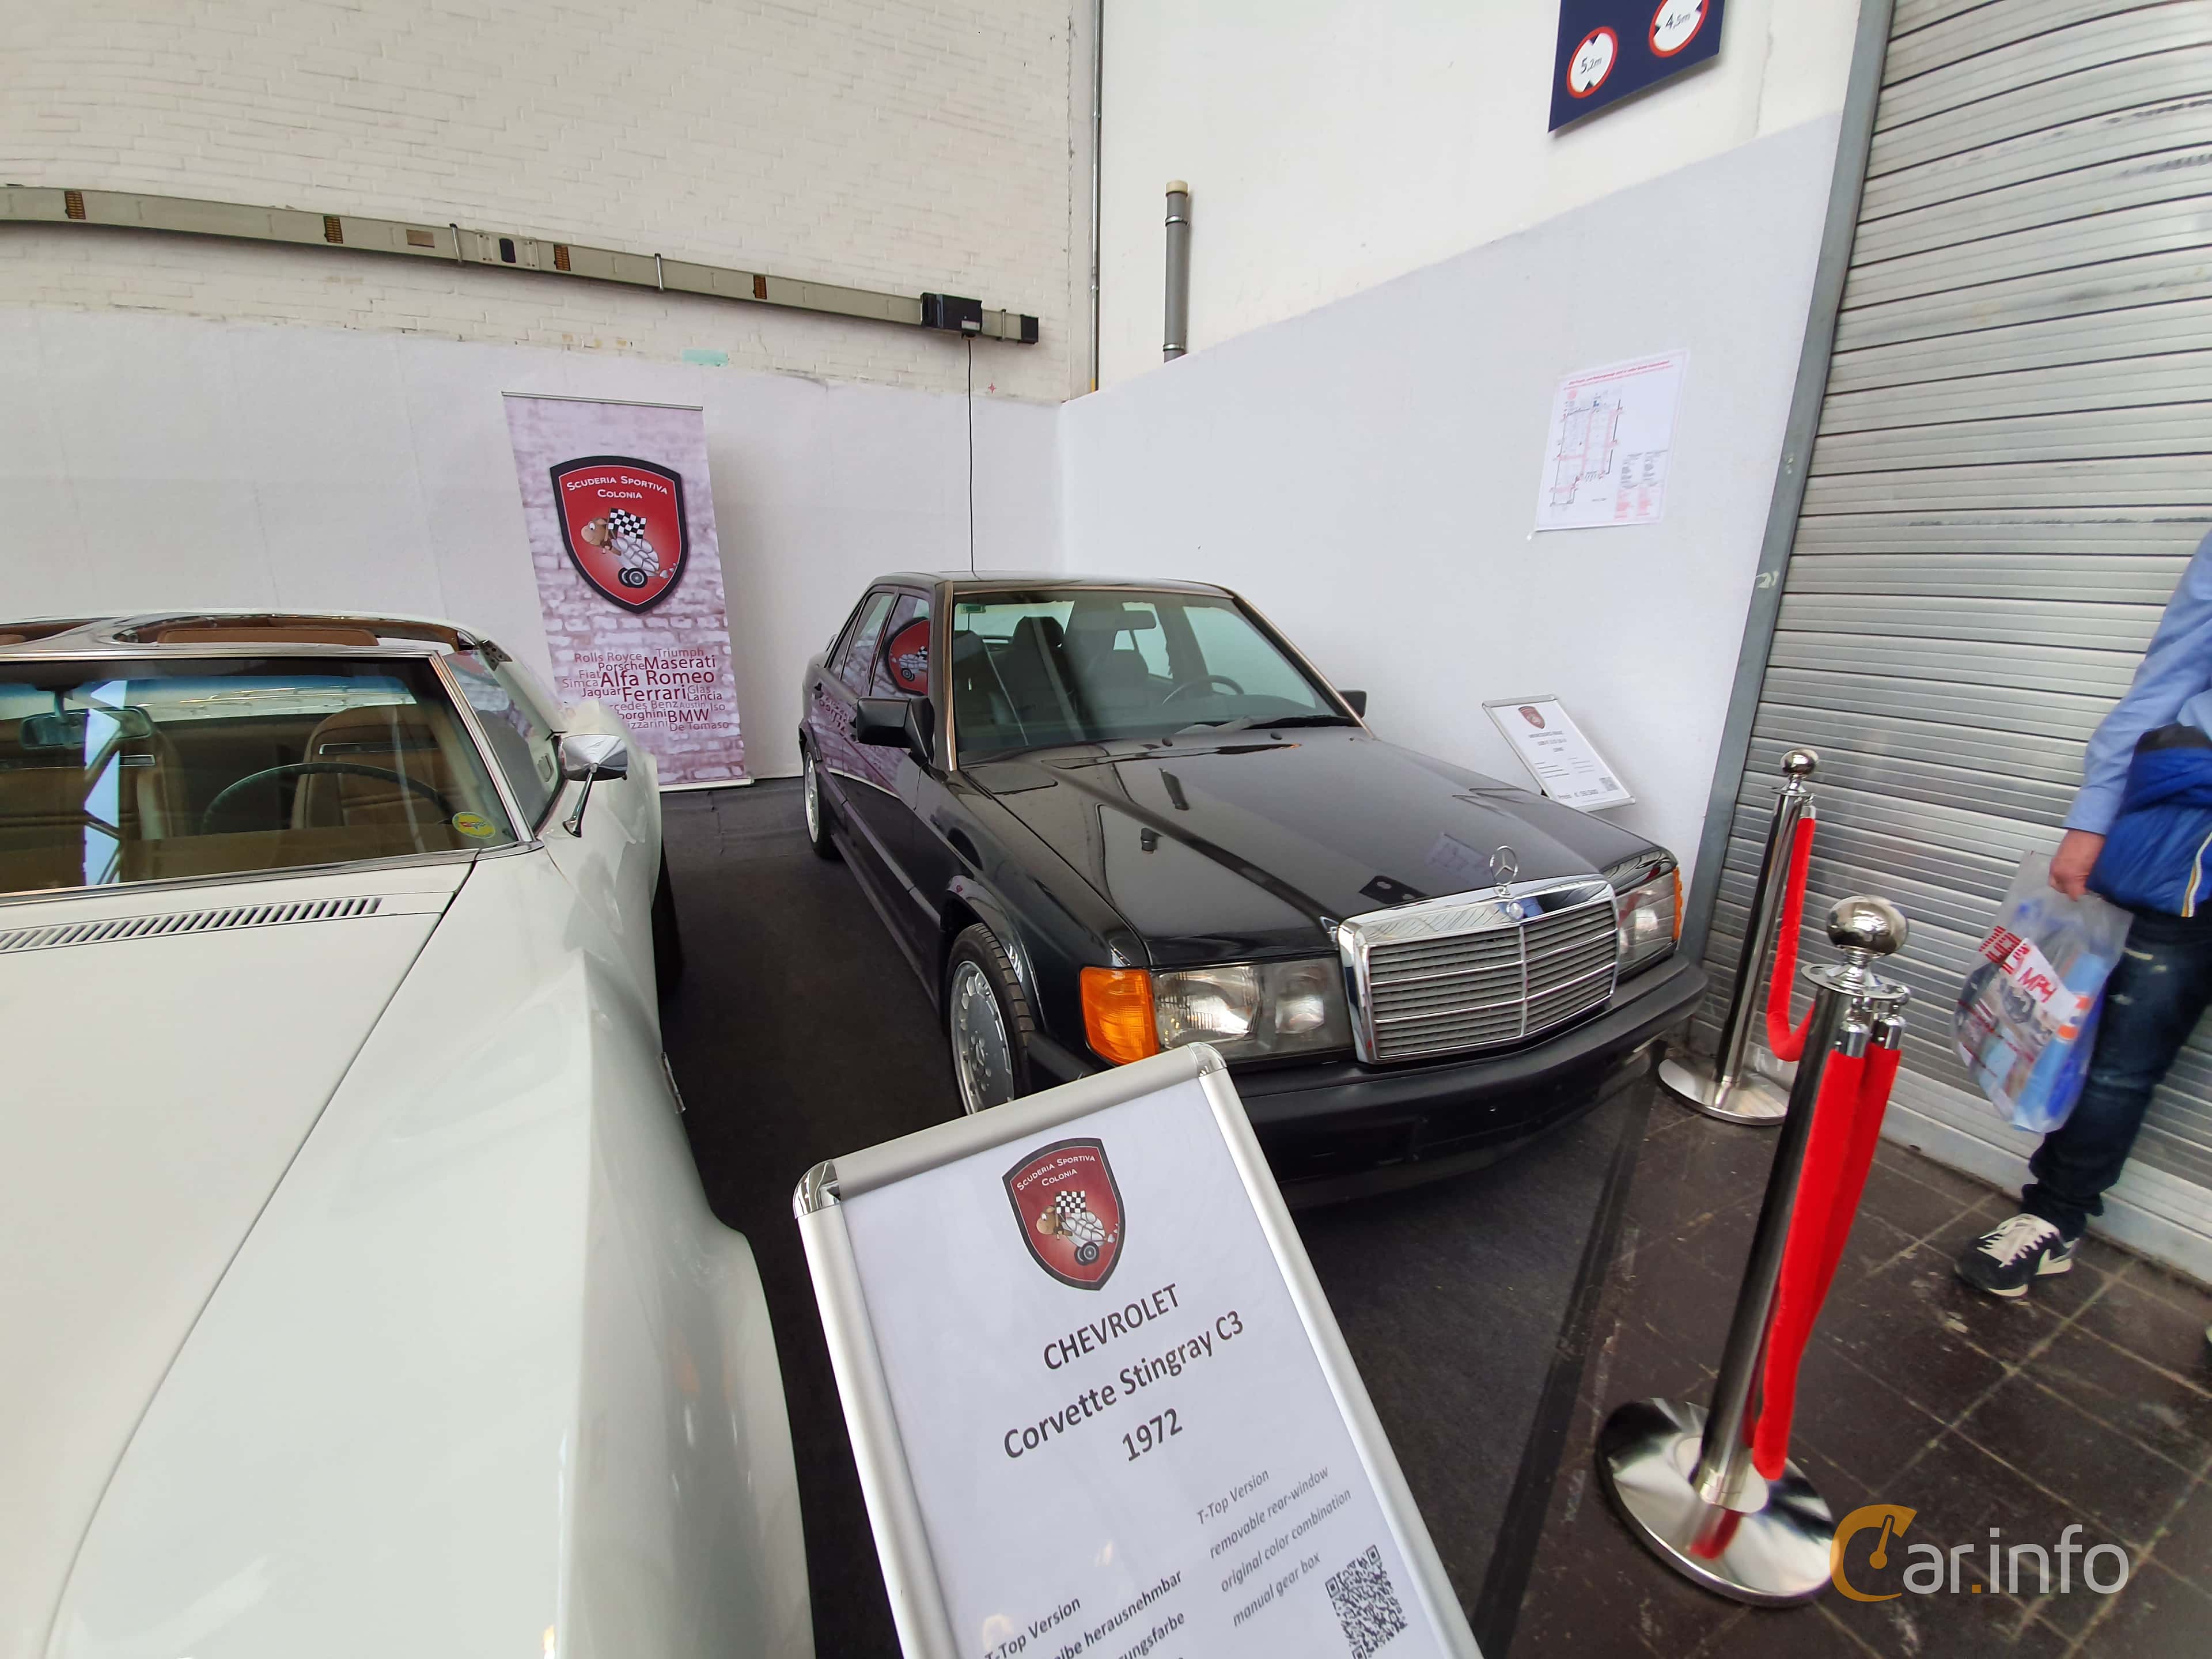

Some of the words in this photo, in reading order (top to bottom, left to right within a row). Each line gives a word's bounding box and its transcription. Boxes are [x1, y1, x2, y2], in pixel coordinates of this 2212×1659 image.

[574, 652, 604, 663] Rolls
[607, 652, 642, 663] Royce
[655, 647, 704, 658] Triumph
[598, 661, 645, 672] Porsche
[645, 654, 716, 669] Maserati
[578, 669, 601, 679] Fiat
[600, 669, 639, 688] Alfa
[646, 670, 714, 685] Romeo
[562, 679, 599, 688] Simca
[687, 685, 711, 694] Glas
[582, 688, 621, 699] Jaguar
[622, 684, 687, 702] Ferrari
[687, 691, 722, 701] Lancia
[609, 701, 647, 711] cedes
[651, 700, 678, 709] Benz
[680, 701, 706, 709] Austin
[710, 702, 726, 711] Iso
[617, 708, 667, 721] borghini
[668, 709, 709, 723] BMW
[627, 718, 668, 729] izzarini
[669, 723, 685, 732] De
[688, 721, 729, 730] Tomaso
[1043, 1282, 1179, 1370] CHEVROLET
[1003, 1384, 1117, 1459] Corvette
[1119, 1330, 1213, 1395] Stingray
[1215, 1310, 1244, 1341] C3
[1122, 1407, 1183, 1461] 1972
[1196, 1498, 1229, 1525] T-Top
[1230, 1469, 1270, 1502] Version
[1210, 1512, 1266, 1559] removable
[1267, 1466, 1329, 1518] rear-window
[1221, 1551, 1263, 1592] original
[1264, 1535, 1290, 1561] color
[1291, 1488, 1352, 1540] combination
[1232, 1584, 1275, 1627] manual
[1275, 1571, 1300, 1597] gear
[1301, 1552, 1321, 1574] box
[1084, 1570, 1183, 1647] herausnehmbar
[1028, 1597, 1081, 1639] Version
